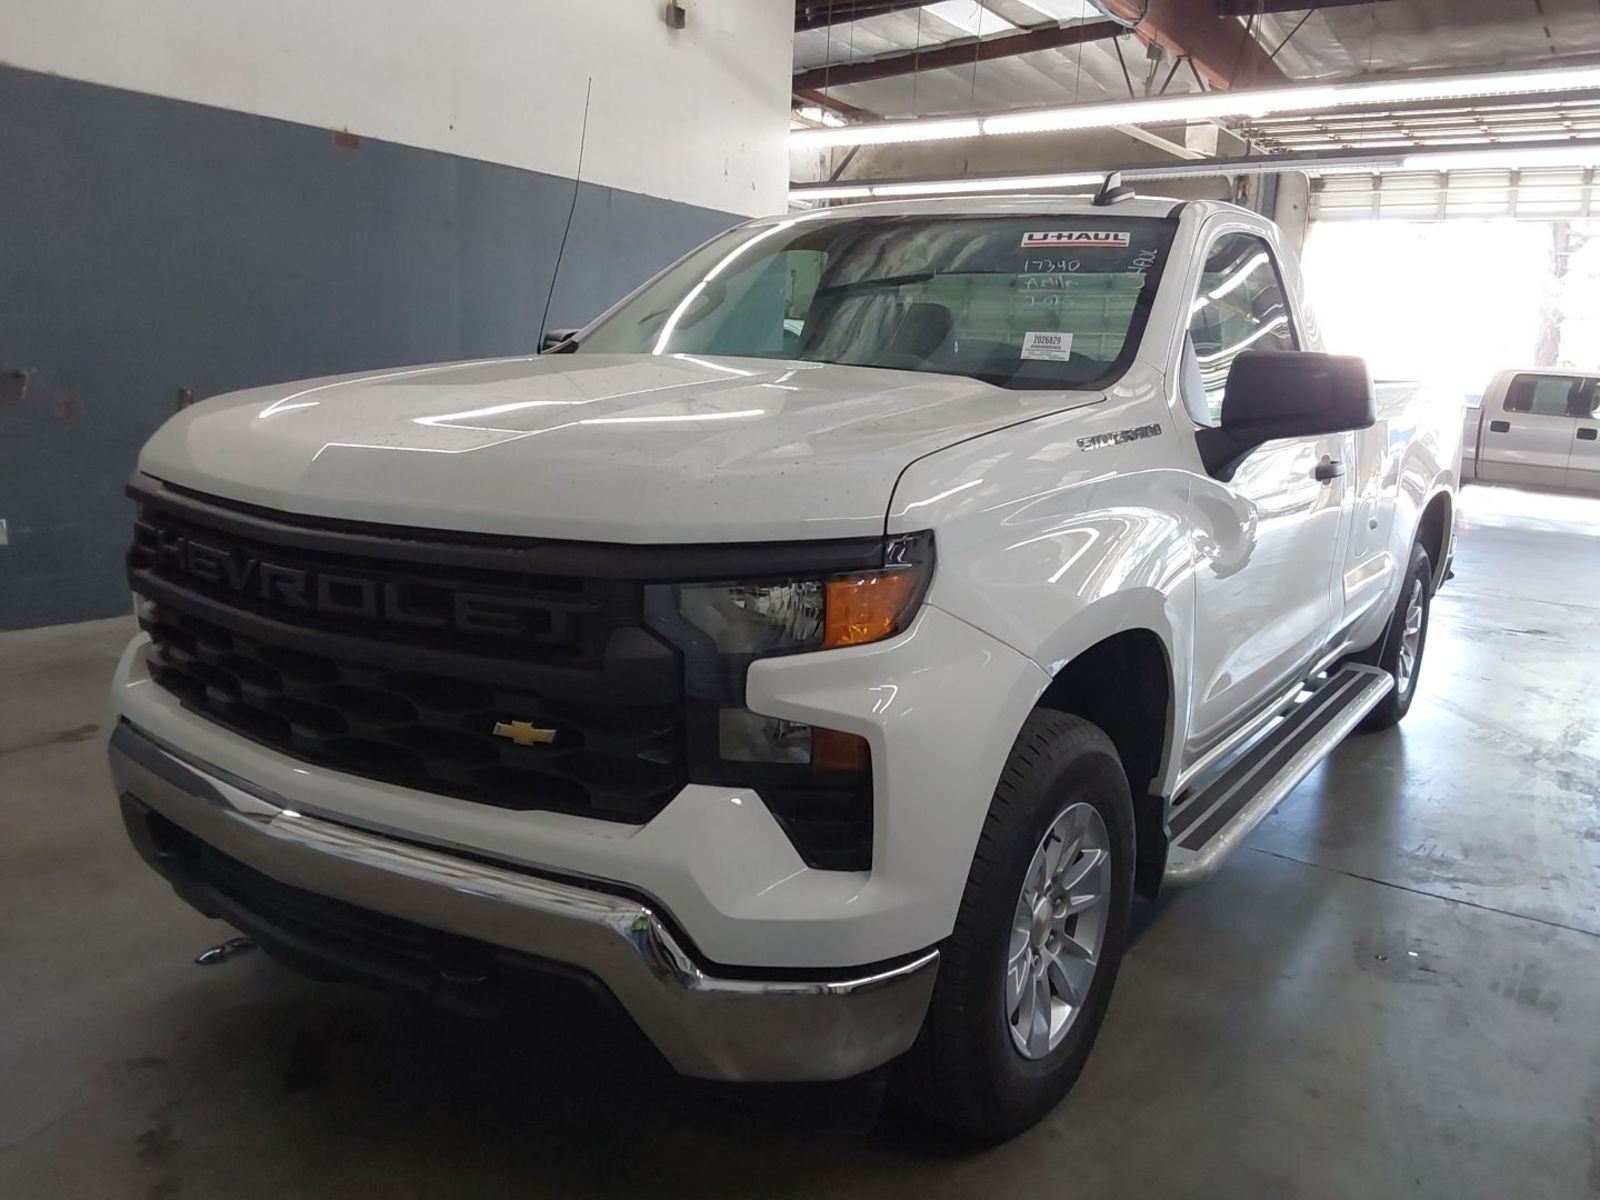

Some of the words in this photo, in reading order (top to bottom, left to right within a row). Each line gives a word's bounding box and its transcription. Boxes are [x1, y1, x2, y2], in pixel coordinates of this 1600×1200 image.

[1027, 232, 1126, 241] U-HAUL
[1024, 259, 1080, 273] 17340
[1032, 335, 1062, 345] 2026829
